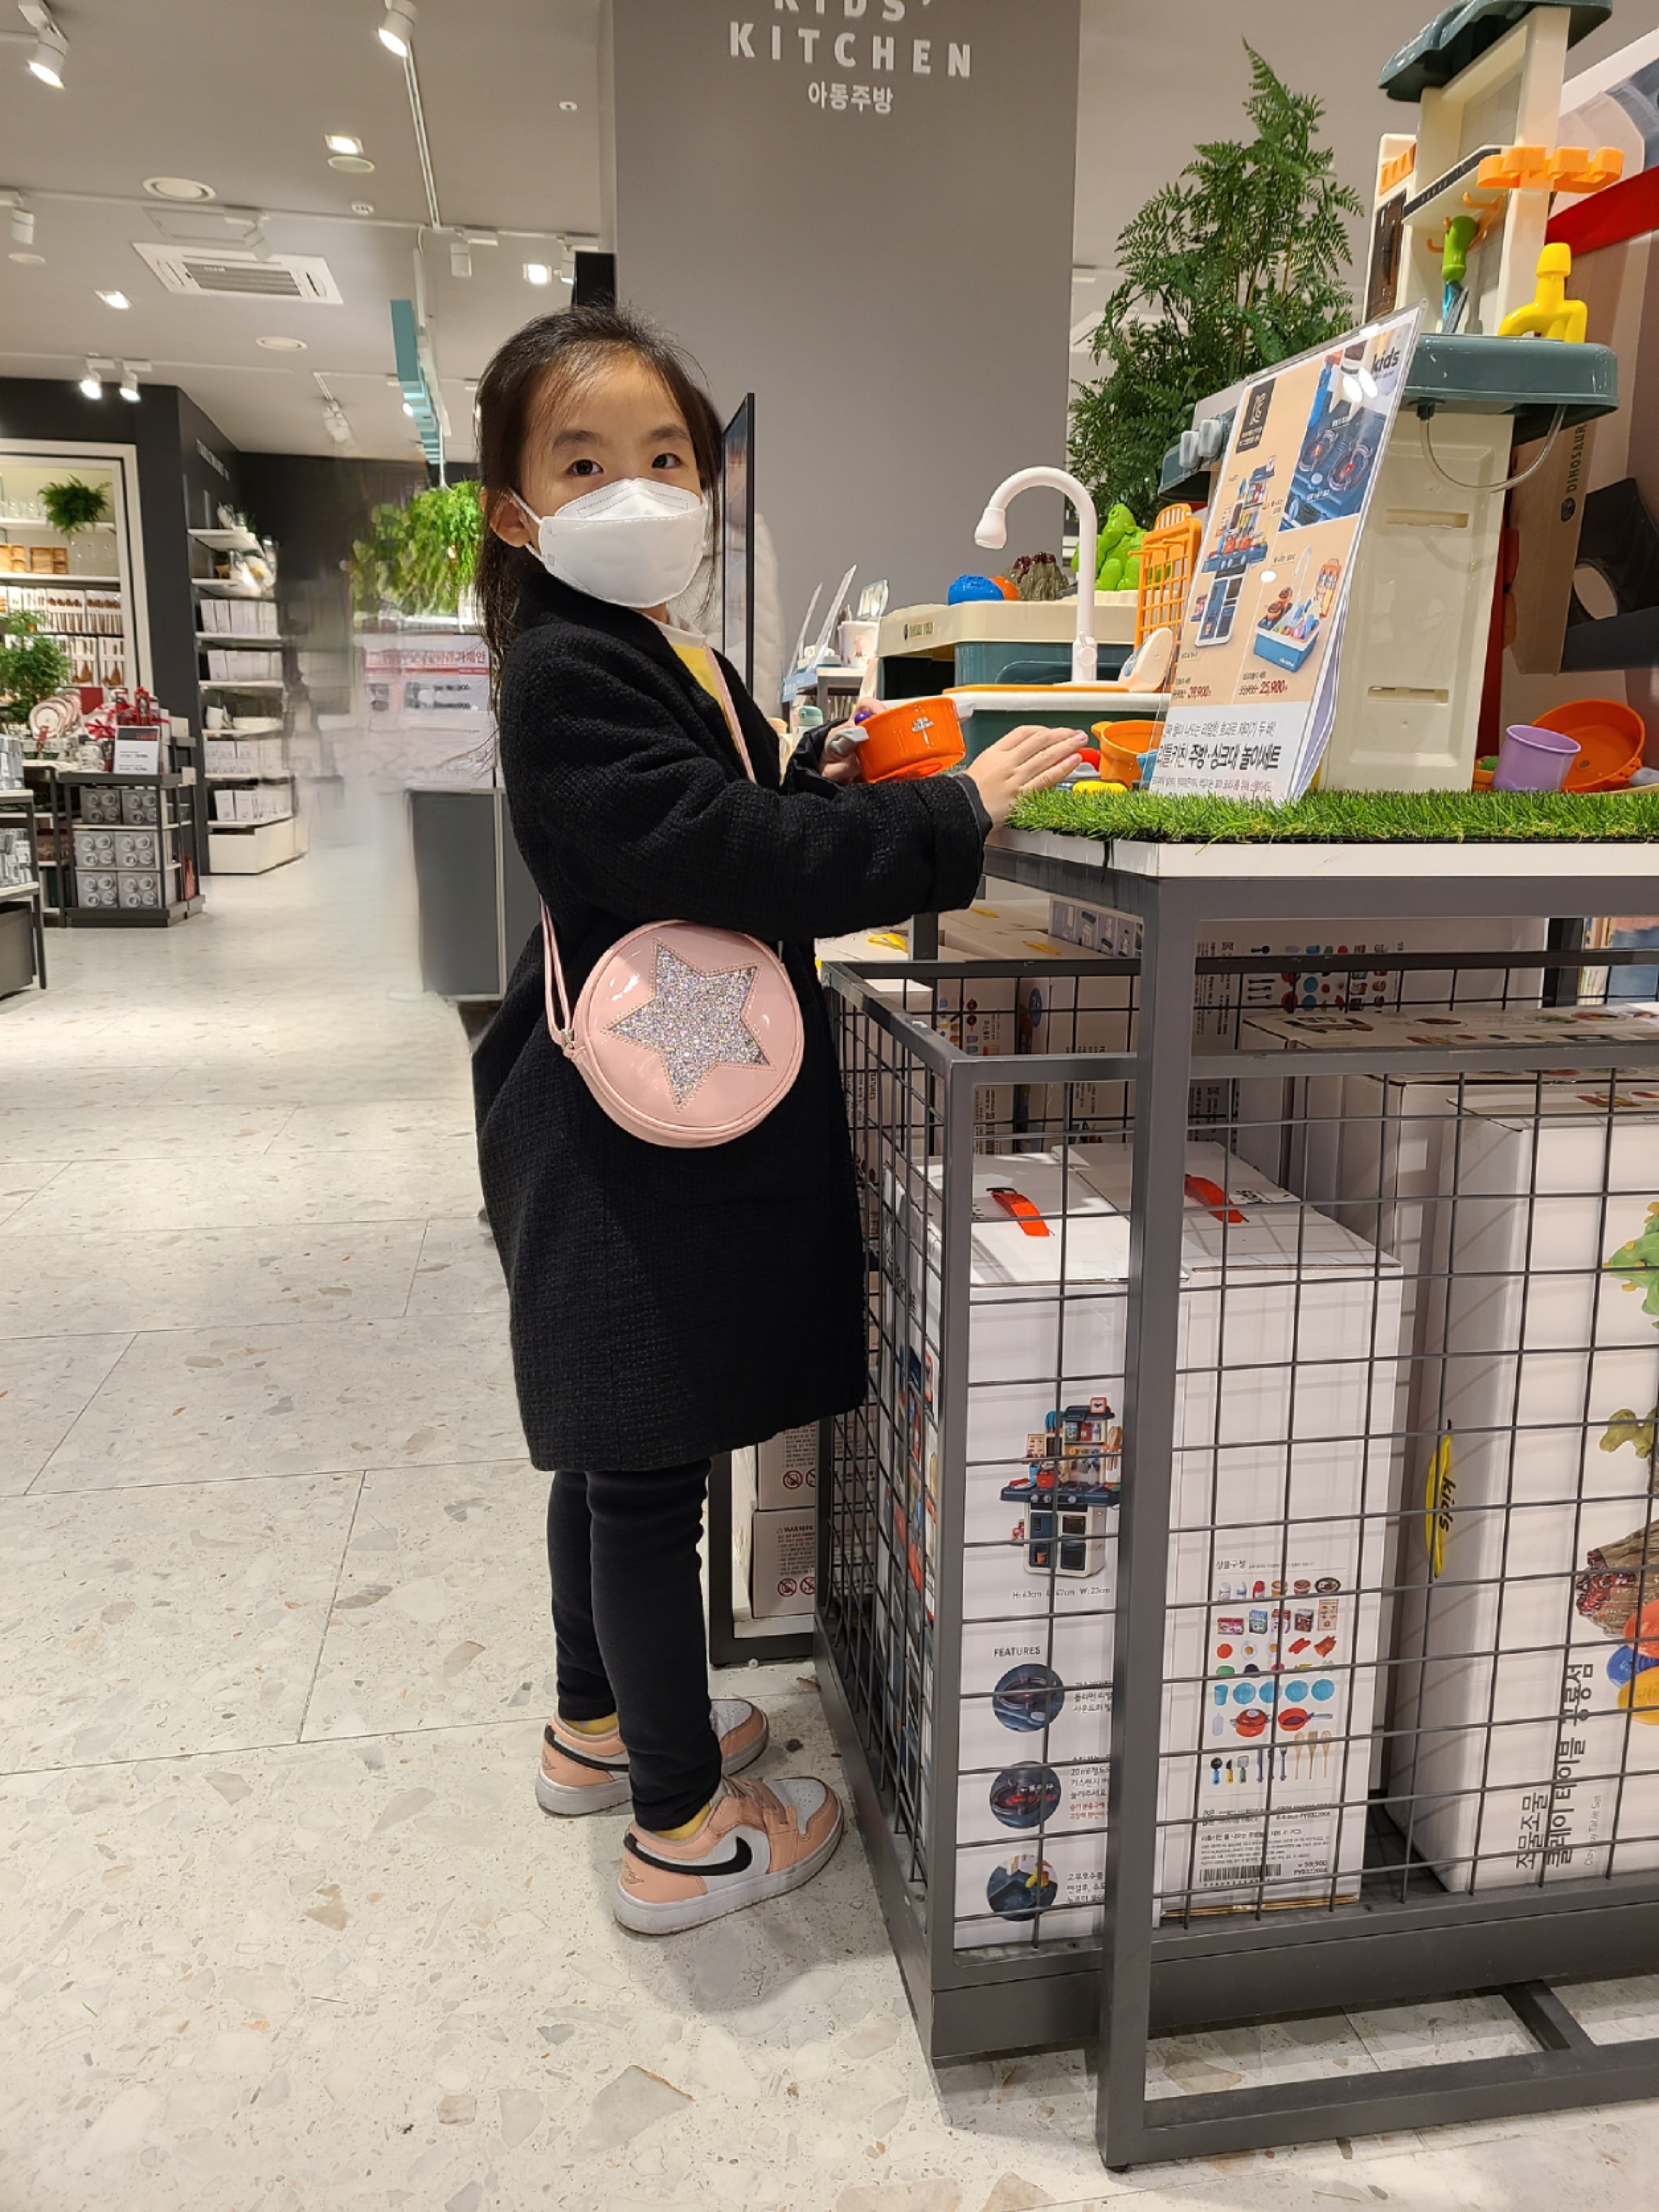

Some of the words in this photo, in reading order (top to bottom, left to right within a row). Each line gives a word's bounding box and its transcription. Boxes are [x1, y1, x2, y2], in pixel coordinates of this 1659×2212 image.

[729, 21, 971, 78] KITCHEN
[808, 81, 894, 114] 아동주방
[1371, 346, 1400, 375] kids
[1566, 424, 1587, 493] DINOSAUR
[1239, 743, 1282, 771] 놀이세트
[1440, 1477, 1456, 1532] kids
[994, 1646, 1041, 1657] FEATURES
[1591, 1795, 1601, 1809] Set
[1515, 1792, 1548, 1870] 조물조물
[1547, 1808, 1575, 1868] 클레이
